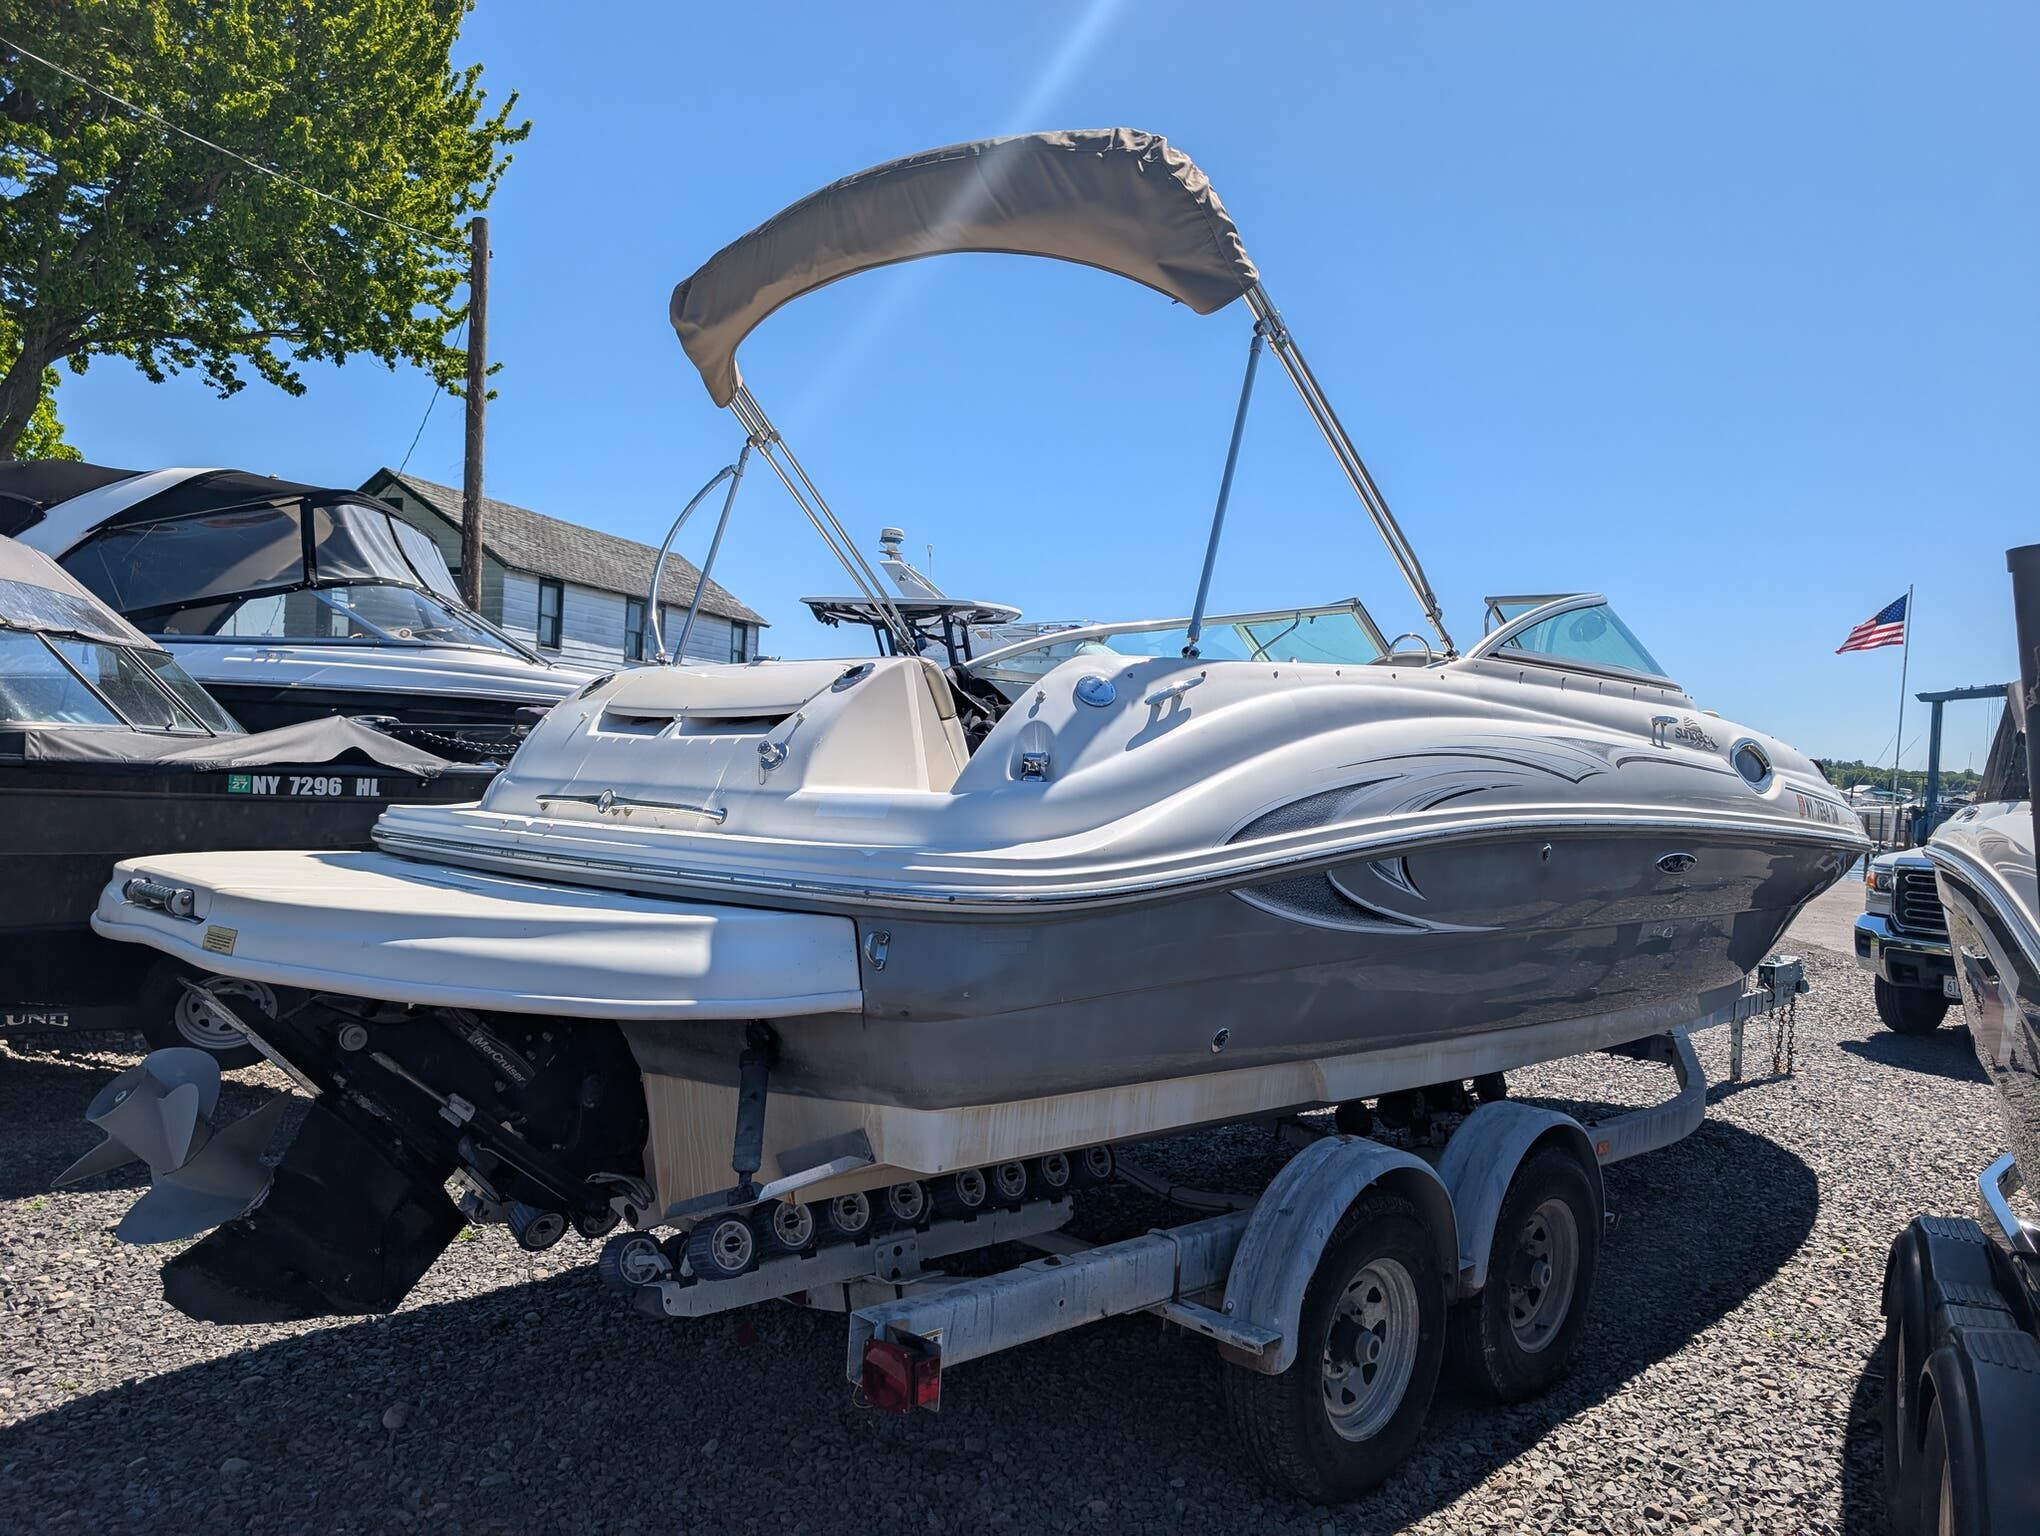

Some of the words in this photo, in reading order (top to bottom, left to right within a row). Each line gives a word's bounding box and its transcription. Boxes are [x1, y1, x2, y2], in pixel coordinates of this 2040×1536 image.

[232, 781, 248, 789] 27
[252, 775, 281, 795] NY
[289, 776, 343, 796] 7296
[355, 777, 380, 797] HL
[473, 1036, 527, 1082] MerCruiser
